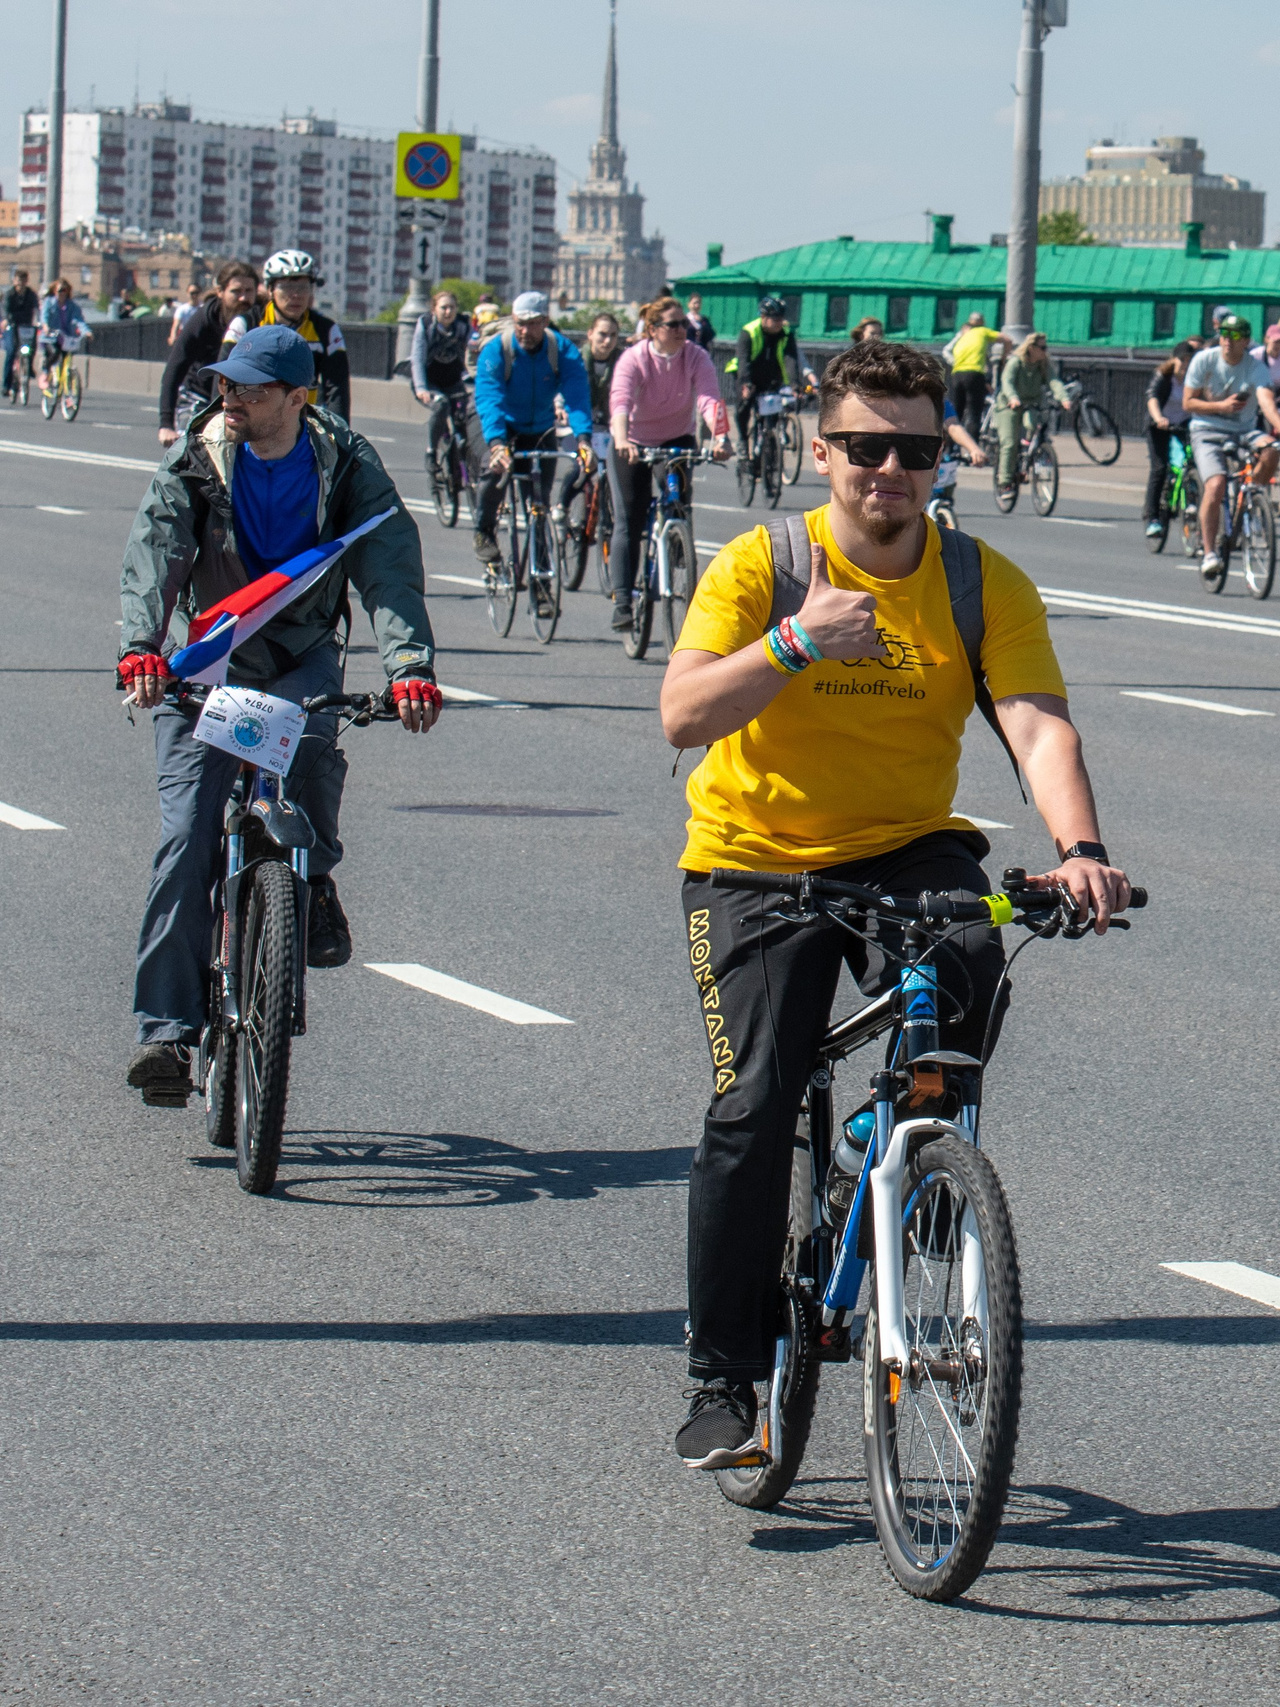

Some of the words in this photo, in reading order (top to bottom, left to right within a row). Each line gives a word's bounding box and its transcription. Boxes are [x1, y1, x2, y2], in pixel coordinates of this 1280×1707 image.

[813, 678, 926, 700] #tinkoffvelo
[245, 697, 274, 714] 07874
[268, 759, 285, 771] EON
[689, 908, 736, 1094] MONTANA
